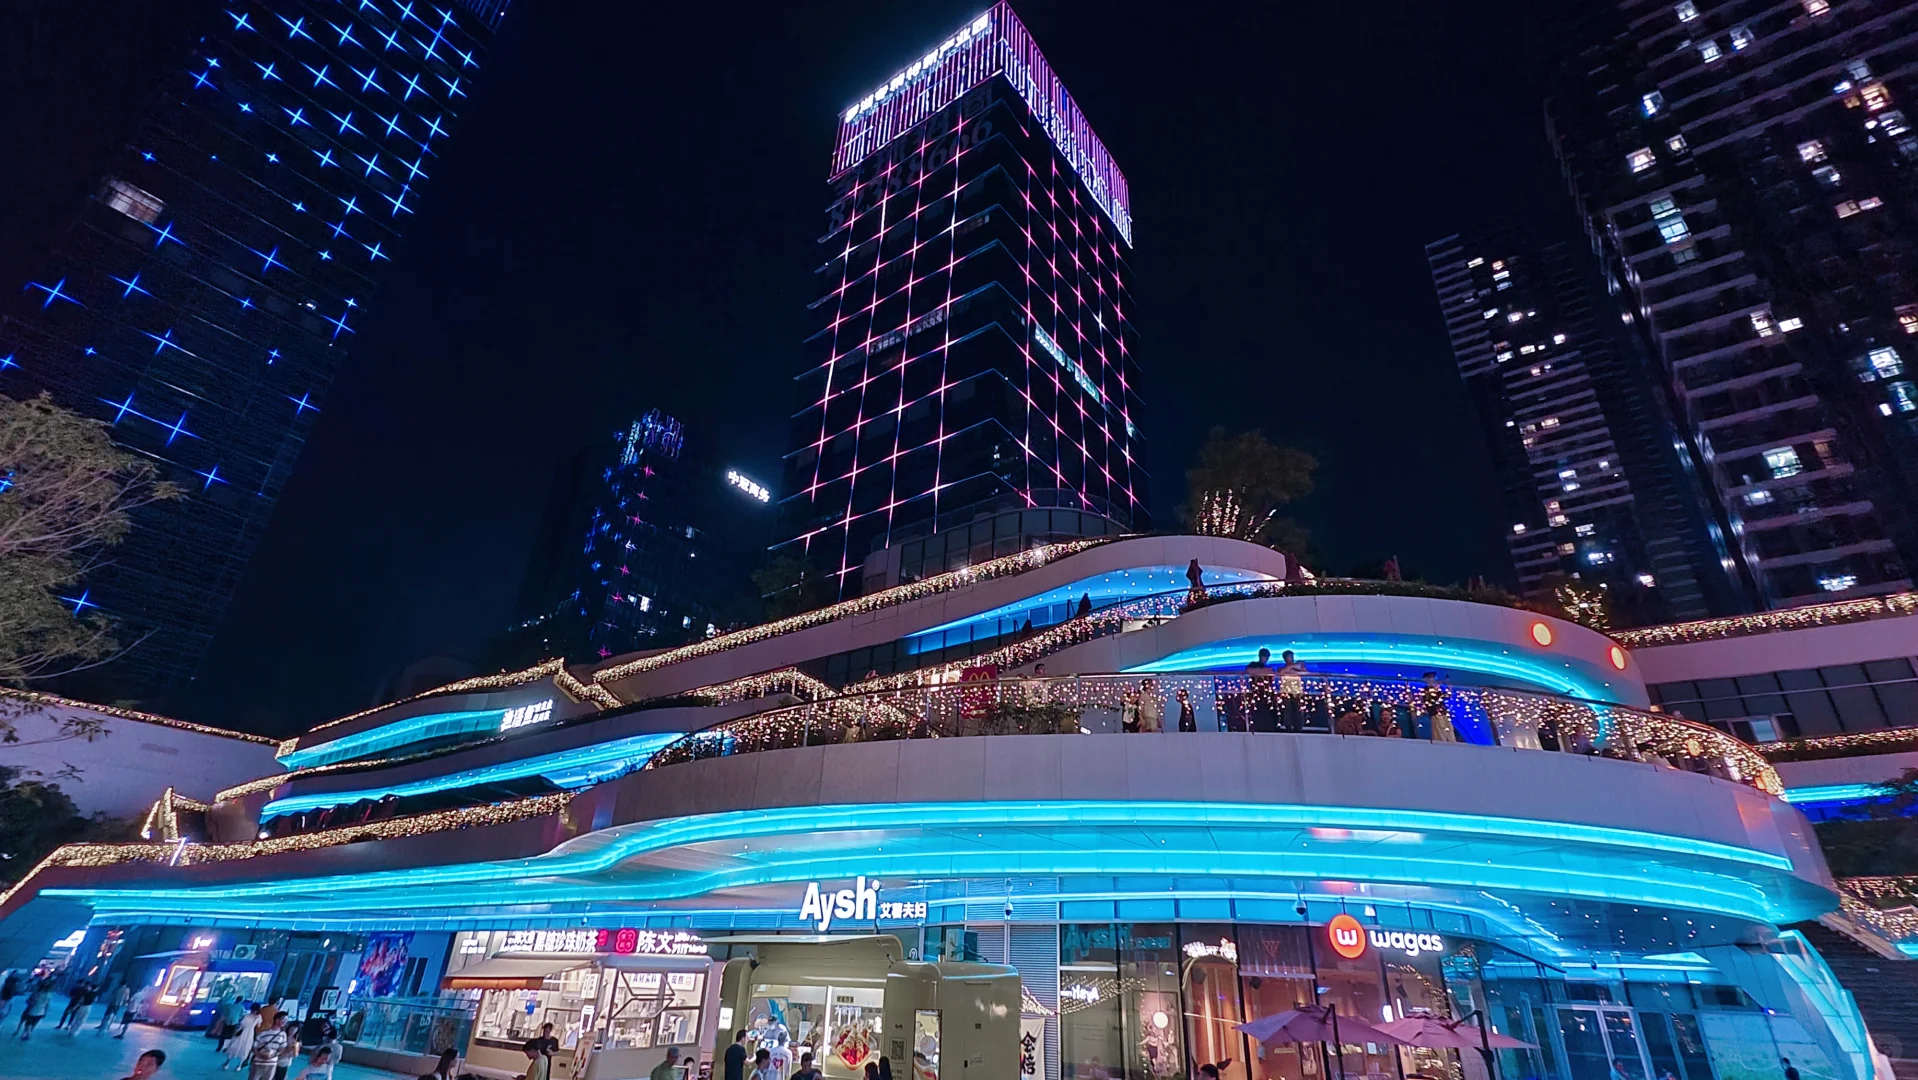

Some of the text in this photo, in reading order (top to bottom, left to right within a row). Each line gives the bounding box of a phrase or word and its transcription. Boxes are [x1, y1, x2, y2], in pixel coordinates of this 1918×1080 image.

[799, 876, 877, 932] Aysh
[1369, 930, 1444, 957] wagas
[311, 1012, 329, 1020] KFC
